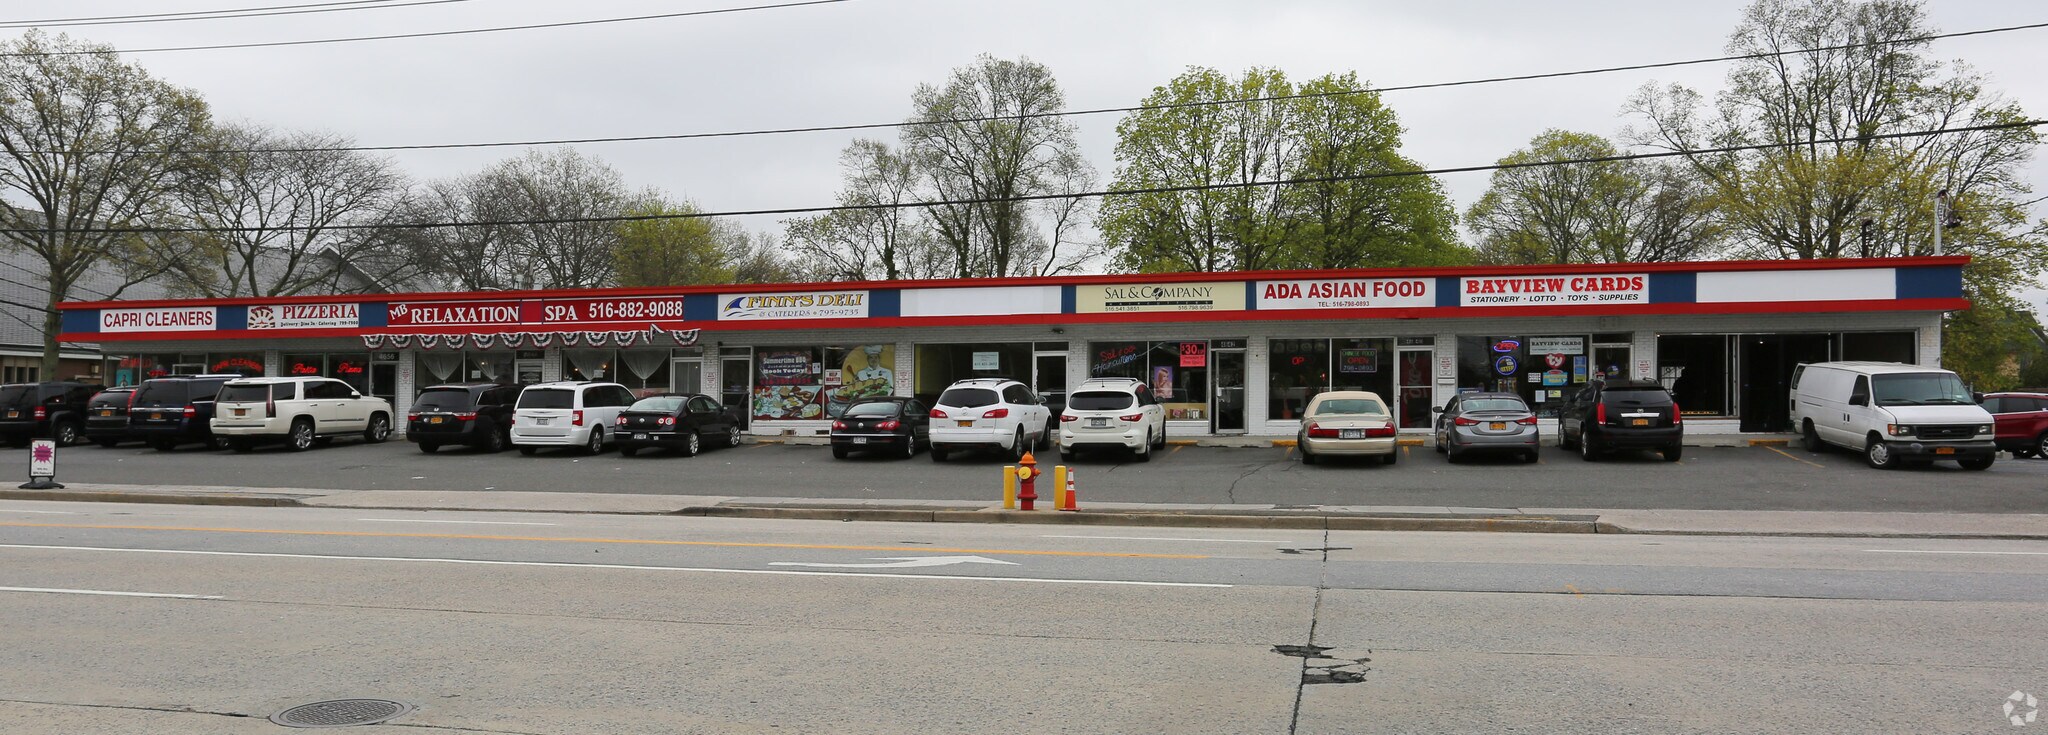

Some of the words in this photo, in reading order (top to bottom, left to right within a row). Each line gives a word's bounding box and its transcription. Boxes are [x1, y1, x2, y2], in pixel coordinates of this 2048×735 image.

[1105, 287, 1126, 299] SAL
[1128, 286, 1139, 299] &
[1264, 284, 1302, 299] ADA
[1308, 282, 1366, 298] ASIAN
[1373, 281, 1426, 297] FOOD
[1466, 279, 1564, 294] BAYVIEW
[1571, 276, 1643, 292] CARDS
[746, 294, 813, 308] FINN'S
[817, 293, 863, 306] DELI
[104, 313, 142, 327] CAPRI
[145, 311, 213, 326] CLEANERS
[282, 304, 358, 319] PIZZERIA
[389, 304, 408, 320] MB
[411, 306, 519, 324] RELAXATION
[545, 305, 578, 321] SPA
[589, 301, 683, 318] 516-882-9088
[1546, 354, 1563, 367] ty
